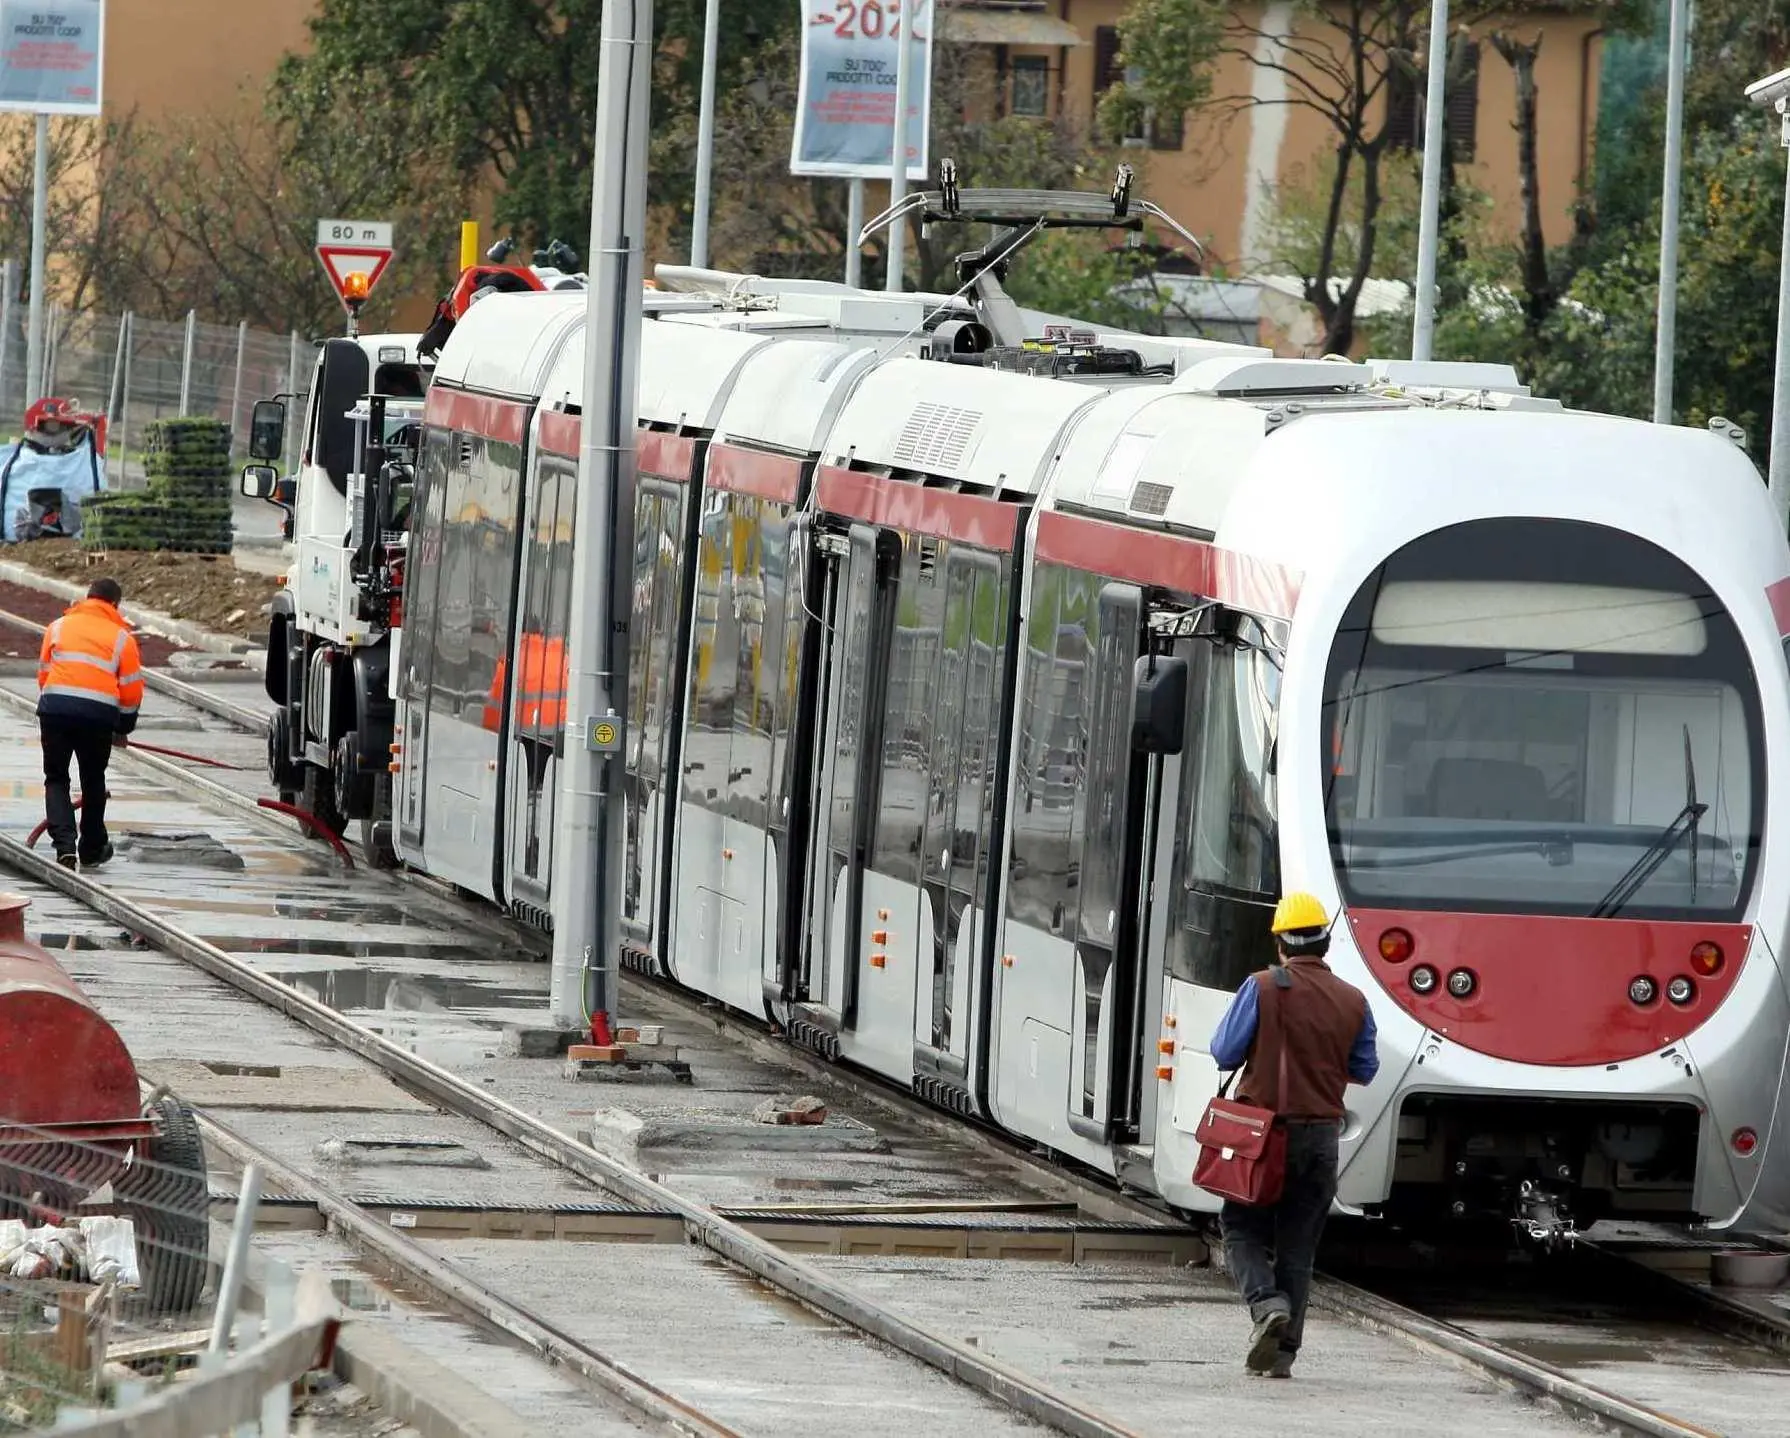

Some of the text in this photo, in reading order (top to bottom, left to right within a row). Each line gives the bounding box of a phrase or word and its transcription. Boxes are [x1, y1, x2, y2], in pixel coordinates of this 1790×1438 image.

[844, 59, 859, 71] SU
[826, 71, 898, 86] PRODOTTI COO
[332, 225, 376, 240] 80 m
